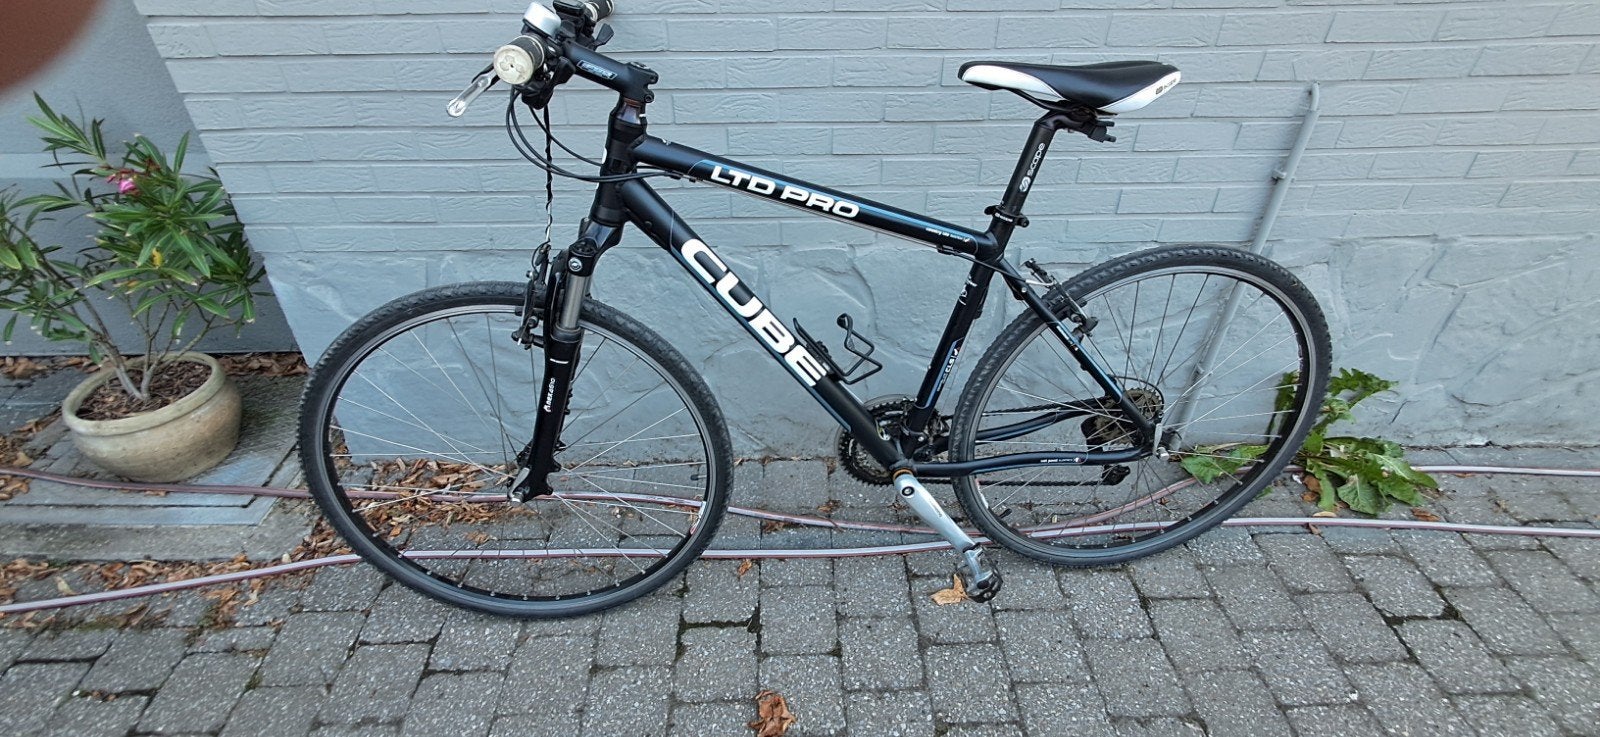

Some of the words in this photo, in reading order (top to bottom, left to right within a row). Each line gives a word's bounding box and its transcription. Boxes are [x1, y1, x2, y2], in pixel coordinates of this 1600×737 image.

[710, 165, 777, 195] LTD
[780, 185, 860, 218] PRO
[681, 238, 828, 388] CUBE
